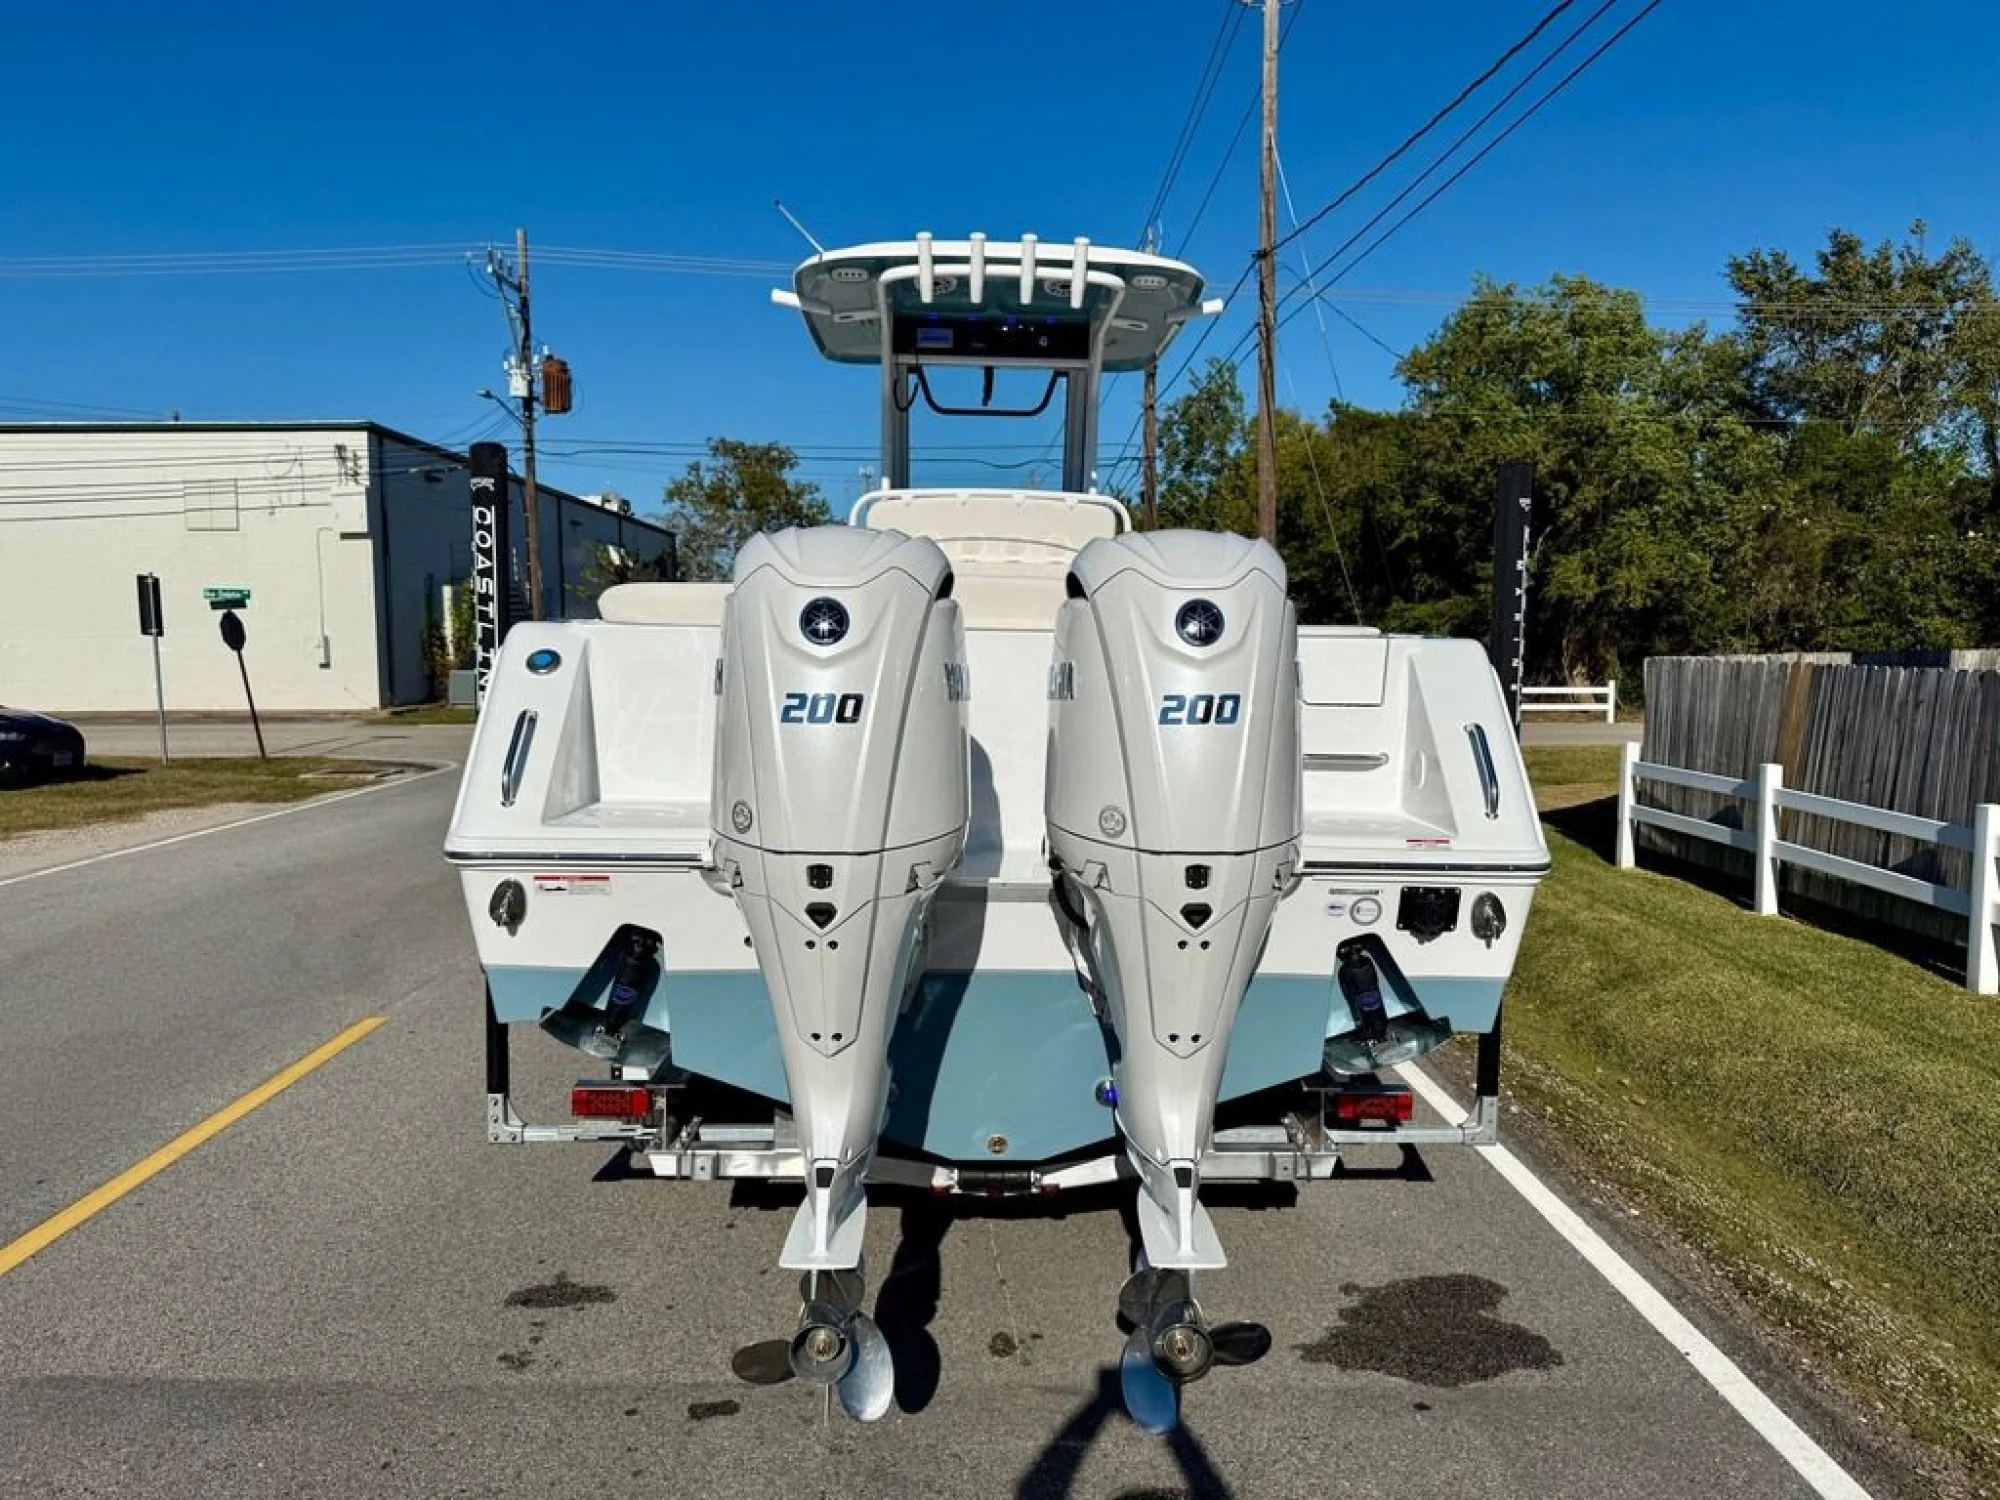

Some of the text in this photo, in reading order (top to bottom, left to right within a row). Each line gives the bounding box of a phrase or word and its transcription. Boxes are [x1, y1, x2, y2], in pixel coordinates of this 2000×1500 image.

[474, 507, 495, 708] COASTLIN
[780, 693, 864, 724] 200
[1158, 694, 1241, 725] 200
